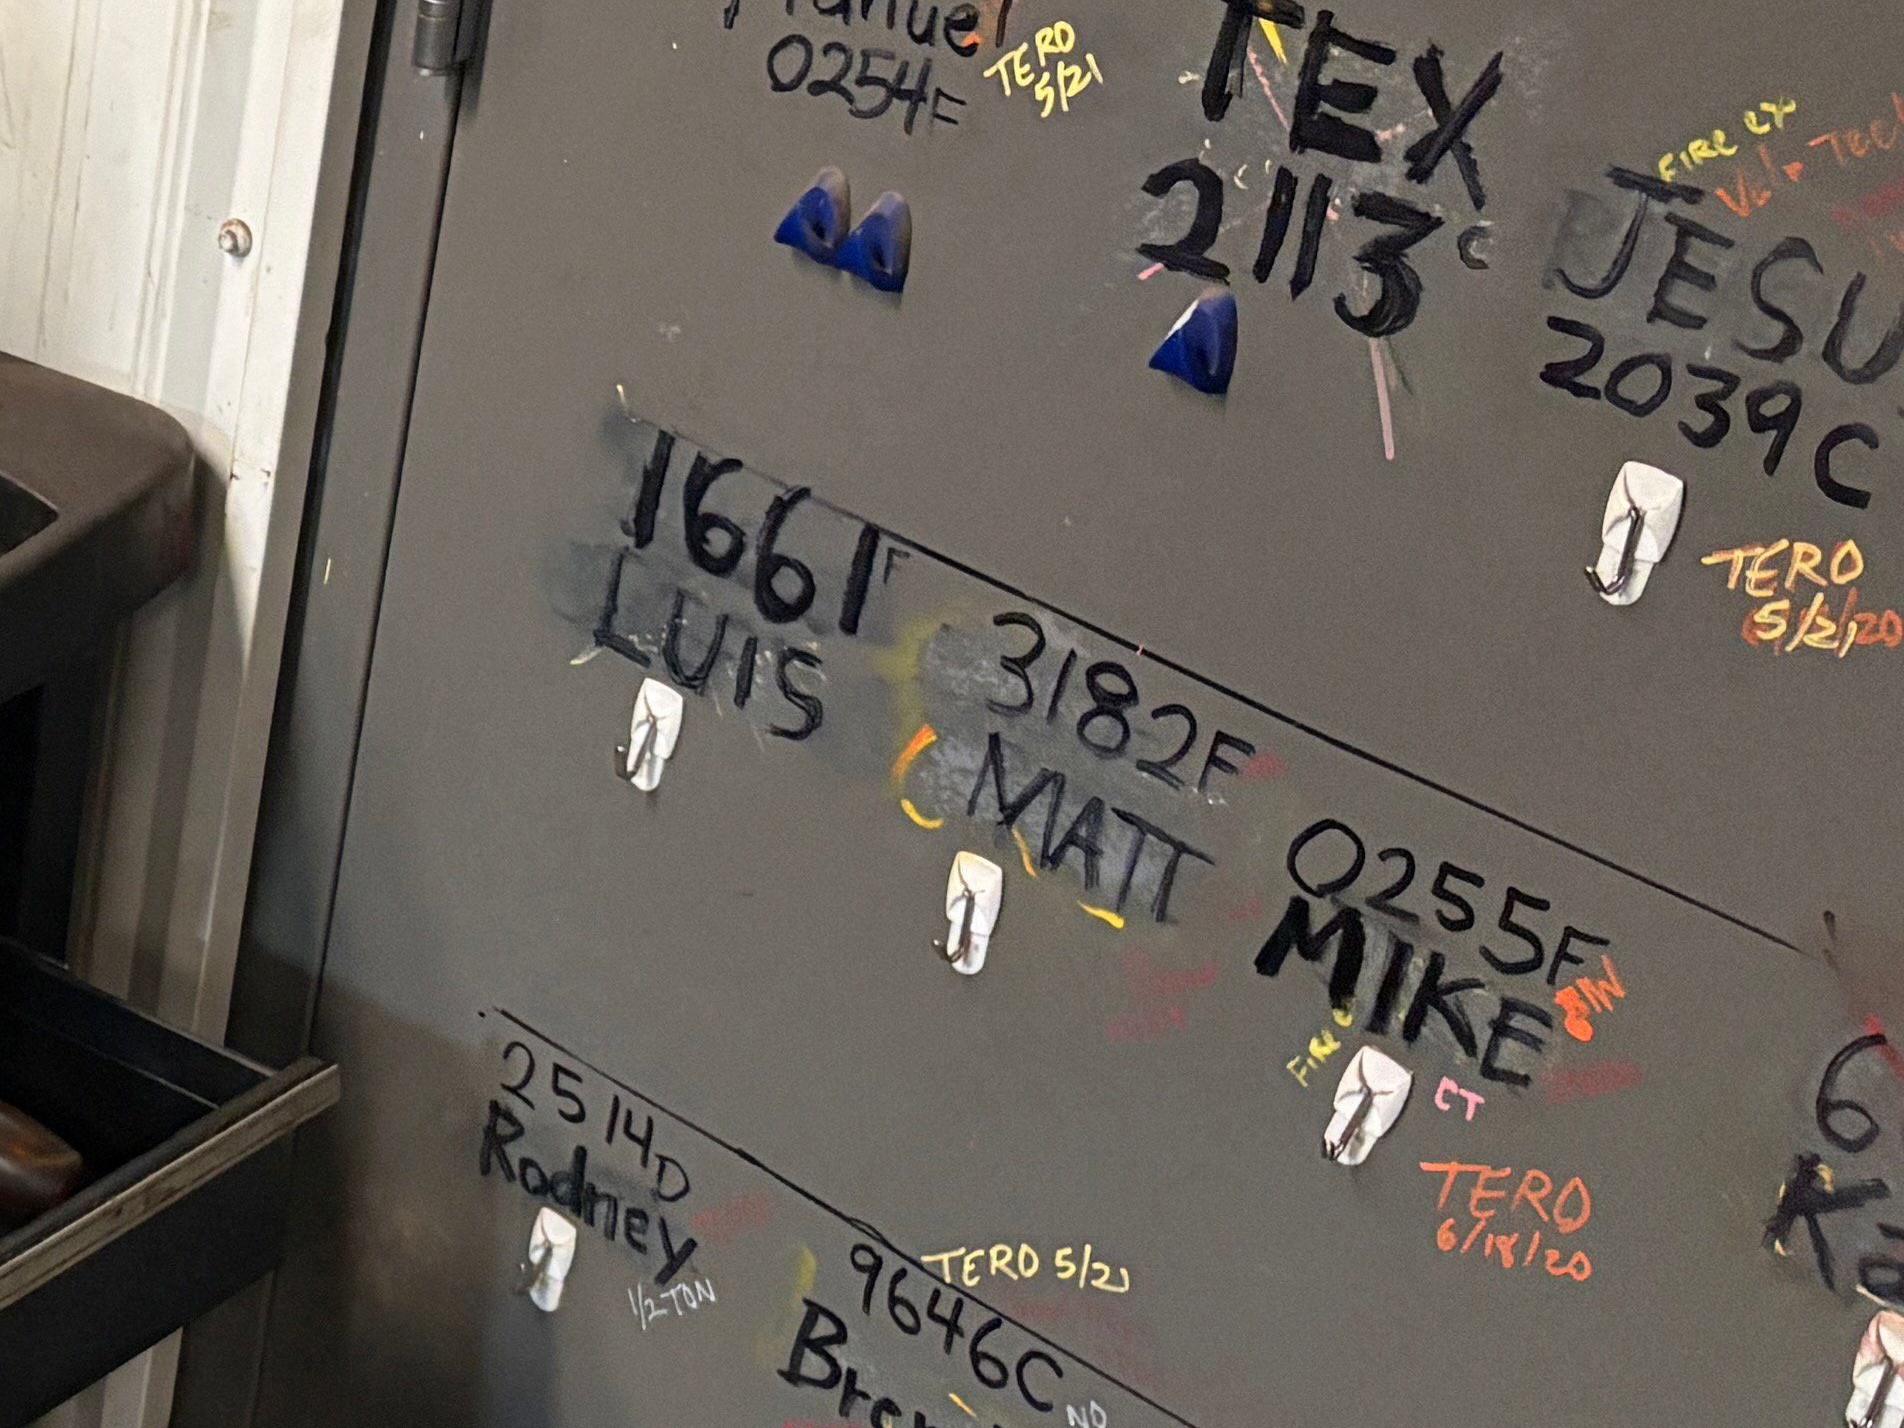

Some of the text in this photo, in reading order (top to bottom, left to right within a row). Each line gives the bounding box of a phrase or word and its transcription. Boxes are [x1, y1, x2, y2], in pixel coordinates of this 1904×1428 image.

[767, 33, 968, 135] 0254F
[1540, 315, 1880, 510] 2039C
[593, 546, 825, 741] LUIS
[1701, 537, 1864, 598] TERO
[984, 609, 1257, 794] 3182F
[967, 730, 1215, 924] MATT
[1287, 818, 1610, 986] 0255F
[1254, 894, 1555, 1090] MIKE
[480, 1098, 699, 1286] Rodney
[500, 1041, 690, 1204] 2514D
[1419, 1160, 1592, 1234] TERO
[659, 1277, 718, 1310] TON
[850, 1242, 1064, 1413] 9646C
[921, 1243, 1040, 1287] TERO
